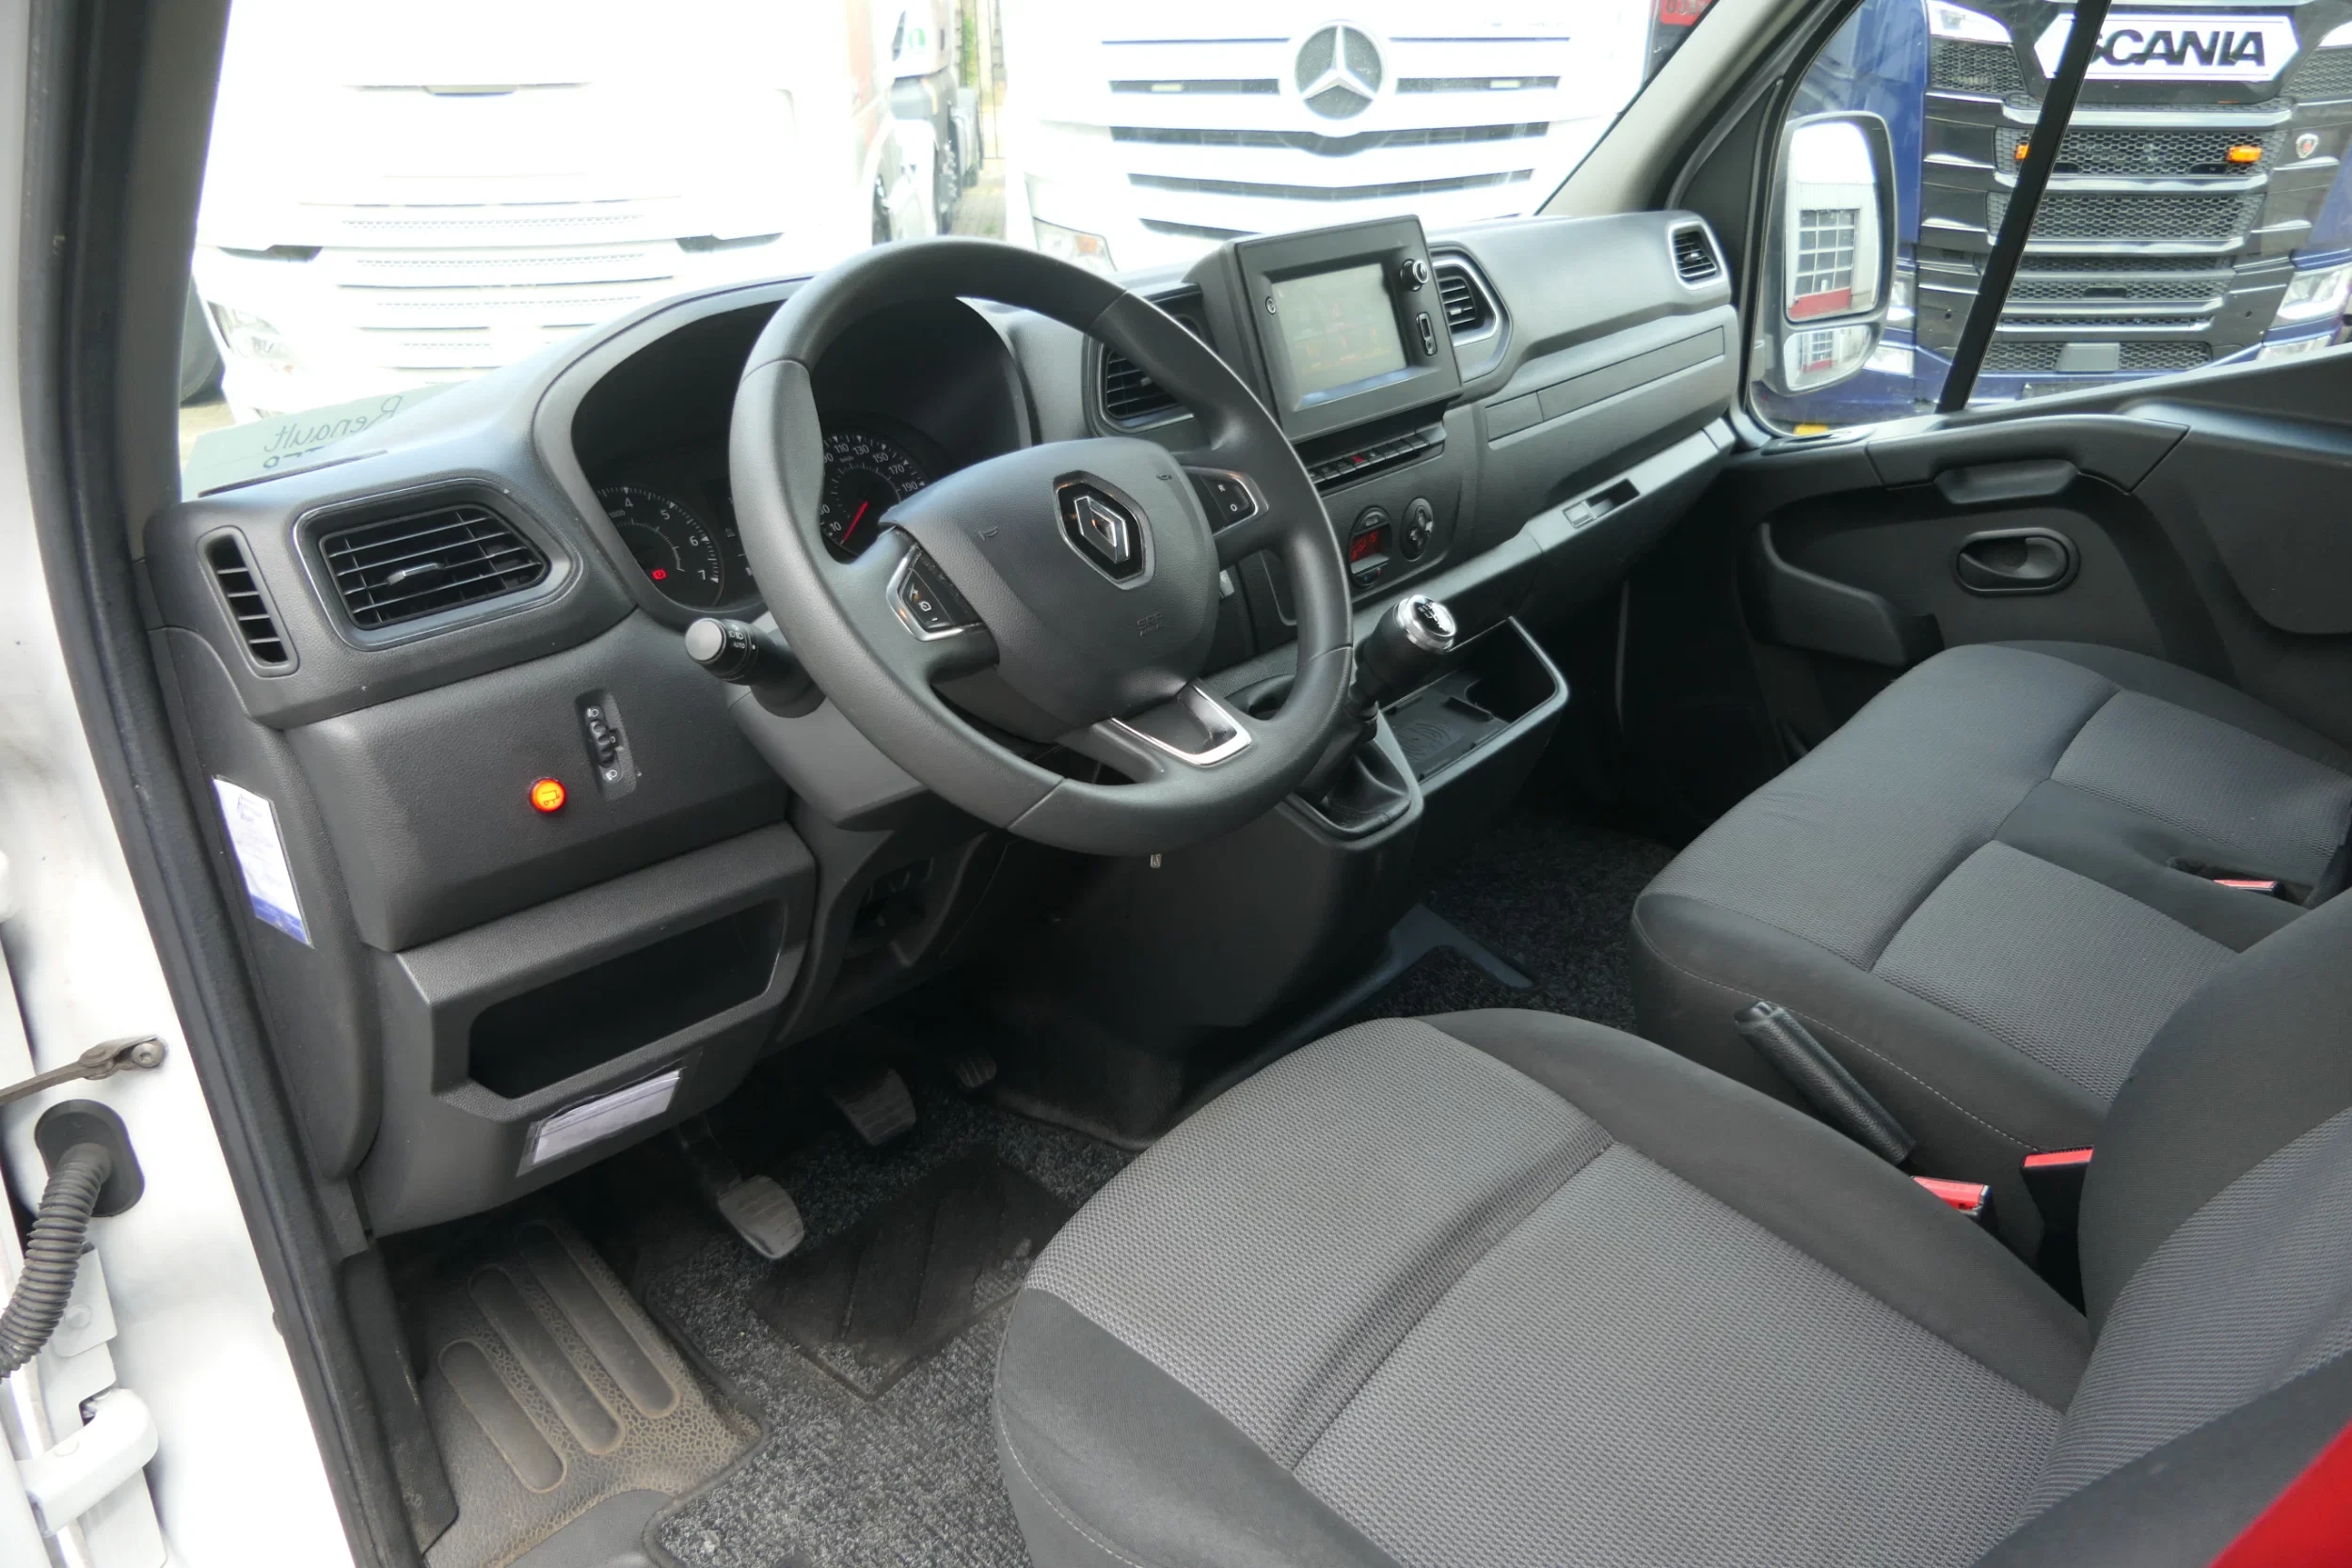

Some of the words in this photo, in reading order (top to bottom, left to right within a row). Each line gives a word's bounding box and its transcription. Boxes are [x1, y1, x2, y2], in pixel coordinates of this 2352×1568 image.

[834, 443, 850, 453] 110
[852, 444, 869, 455] 130
[872, 453, 889, 463] 150
[888, 464, 904, 475] 170
[901, 481, 918, 492] 190
[625, 498, 633, 508] 4
[660, 509, 671, 519] 5
[830, 521, 842, 531] 10
[689, 535, 699, 546] 6
[697, 569, 707, 580] 7
